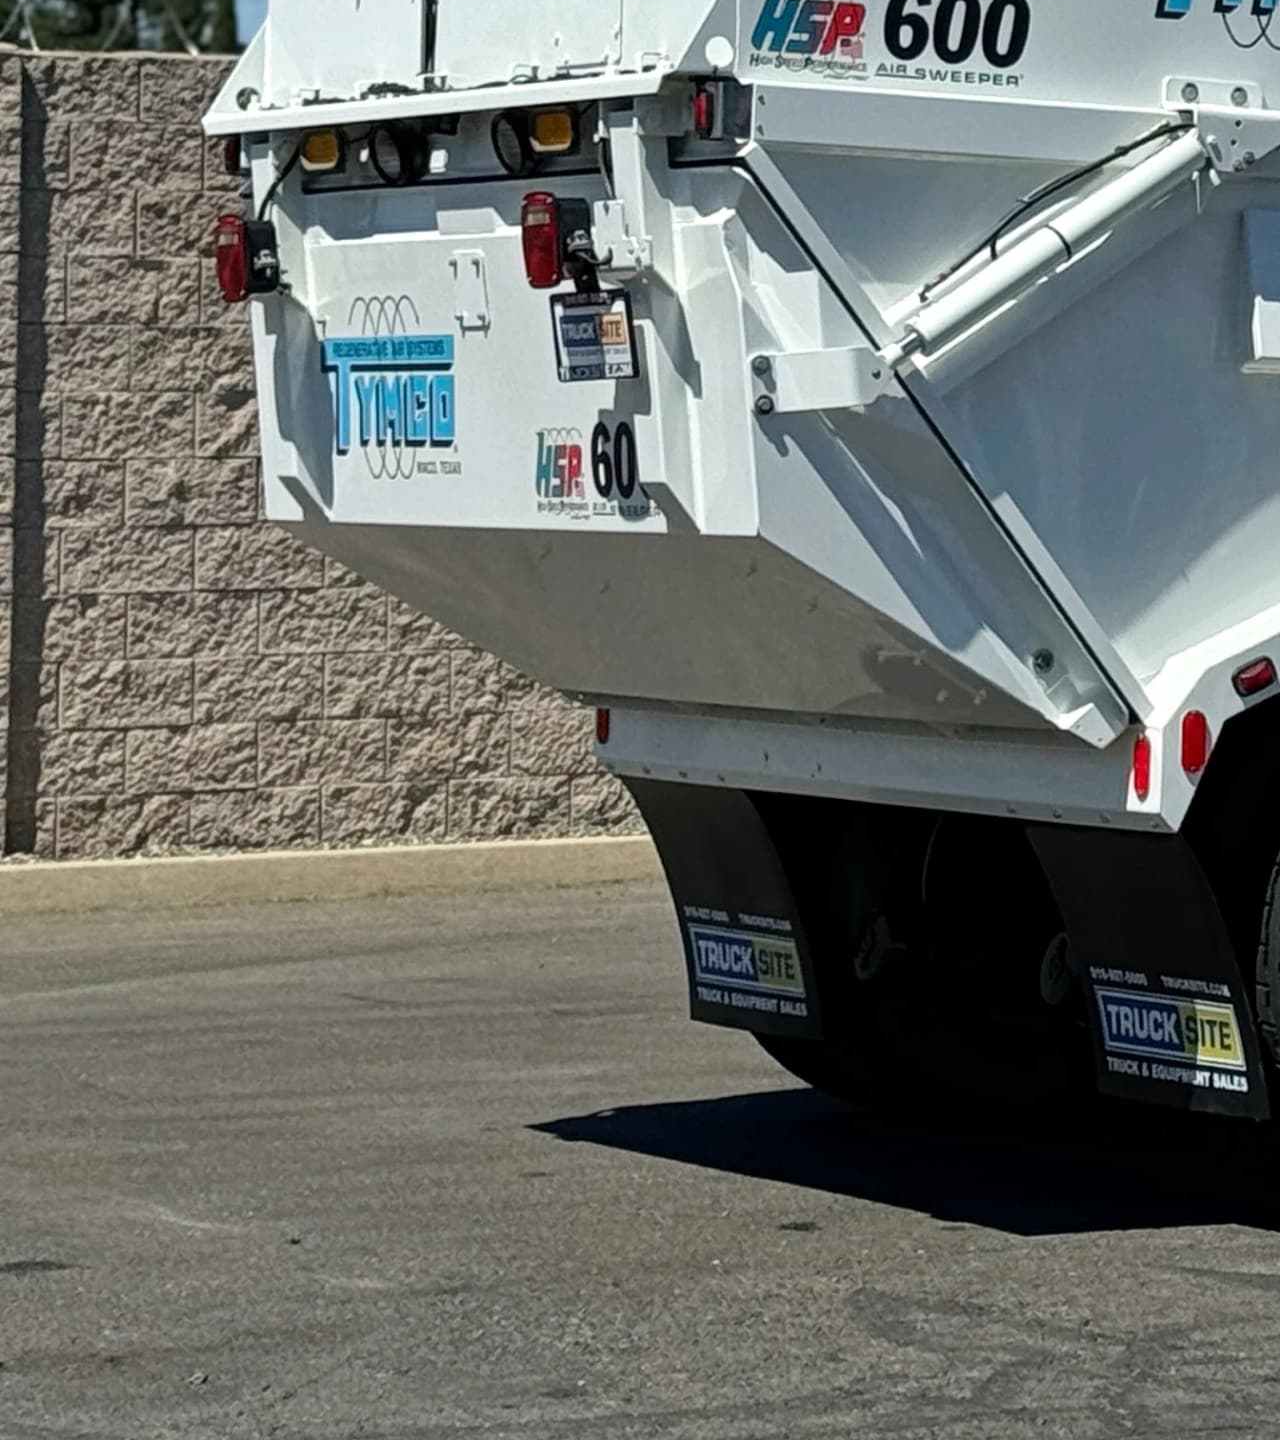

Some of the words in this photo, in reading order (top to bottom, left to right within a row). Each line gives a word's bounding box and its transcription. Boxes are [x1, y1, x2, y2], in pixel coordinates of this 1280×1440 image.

[875, 62, 908, 77] AIR
[914, 67, 1020, 86] SWEEPER
[321, 334, 456, 456] TYMCO
[536, 431, 583, 499] HSP
[591, 420, 650, 500] 60
[698, 939, 755, 974] TRUCK
[758, 949, 796, 980] SITE
[1106, 1003, 1180, 1045] TRUCK
[1185, 1015, 1232, 1051] SITE
[1213, 1071, 1249, 1092] SALES
